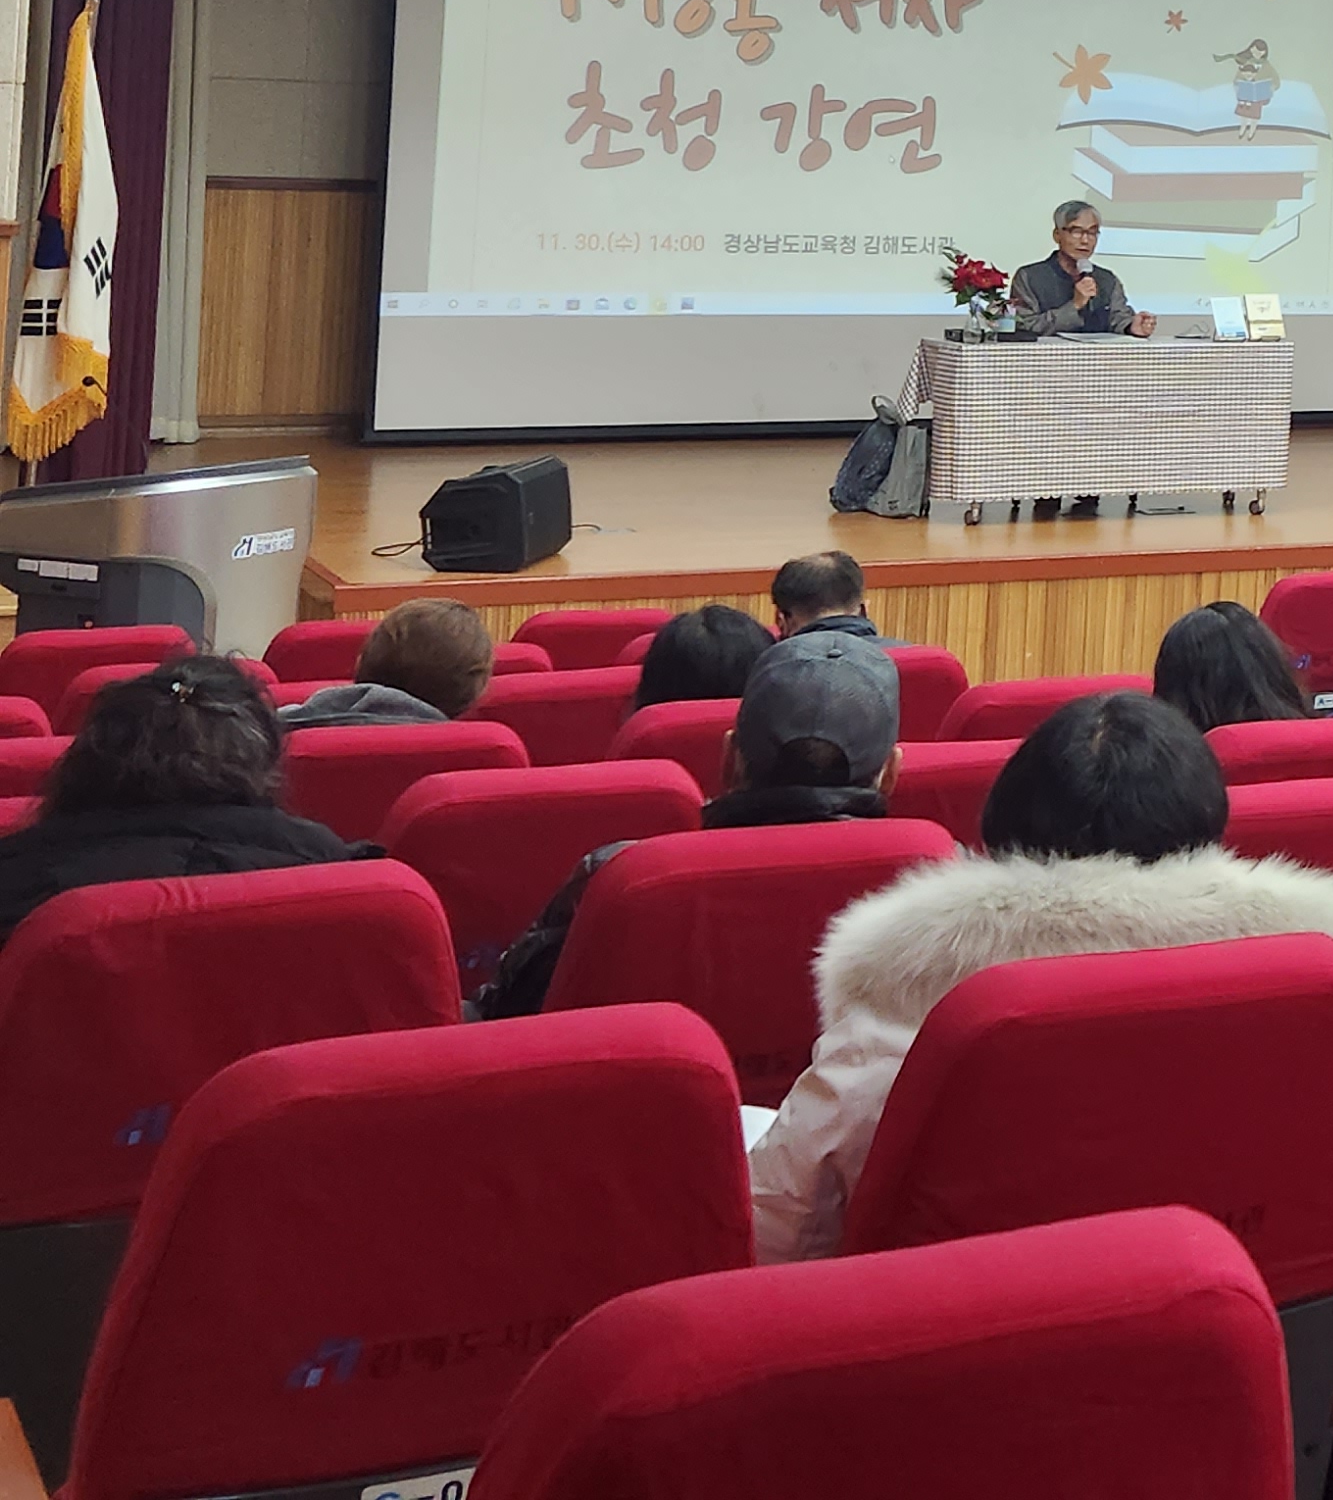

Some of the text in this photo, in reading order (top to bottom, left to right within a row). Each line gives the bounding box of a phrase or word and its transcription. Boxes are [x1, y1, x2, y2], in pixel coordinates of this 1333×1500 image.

[564, 60, 943, 175] 초청 강연
[537, 231, 956, 256] 11. 30.(수) 14:00 경상남도교육청 김해도서관
